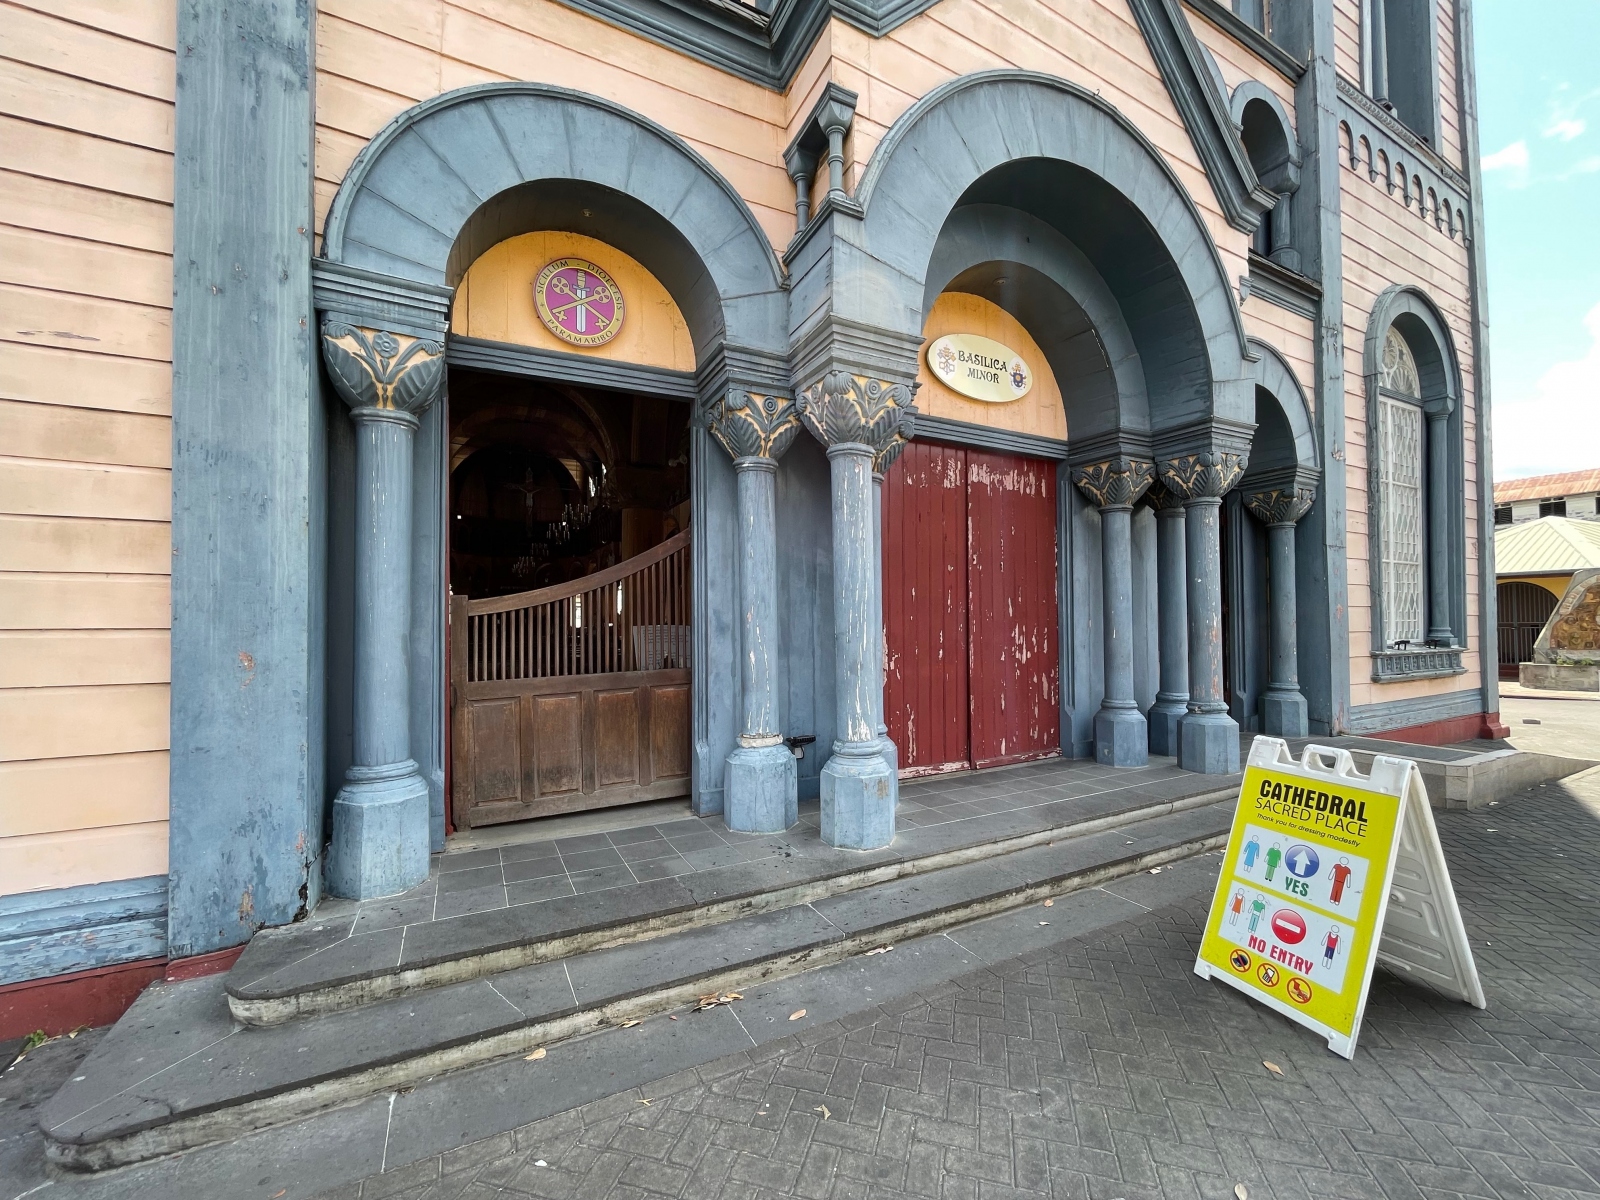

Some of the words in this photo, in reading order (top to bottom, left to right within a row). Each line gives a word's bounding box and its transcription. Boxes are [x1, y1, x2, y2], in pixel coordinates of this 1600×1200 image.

[587, 263, 623, 311] DIOECESIS
[547, 319, 613, 343] PARAMARIBO
[958, 350, 1008, 371] BASILICA
[967, 367, 1000, 383] MINOR
[1260, 779, 1368, 823] CATHEDRAL
[1255, 797, 1311, 821] SACRED
[1315, 812, 1368, 838] PLACE
[1275, 818, 1288, 829] you
[1288, 821, 1298, 830] for
[1298, 824, 1326, 838] dressing
[1326, 834, 1361, 848] modestly
[1285, 876, 1309, 897] YES
[1248, 934, 1267, 954] NO
[1269, 944, 1314, 975] ENTRY
